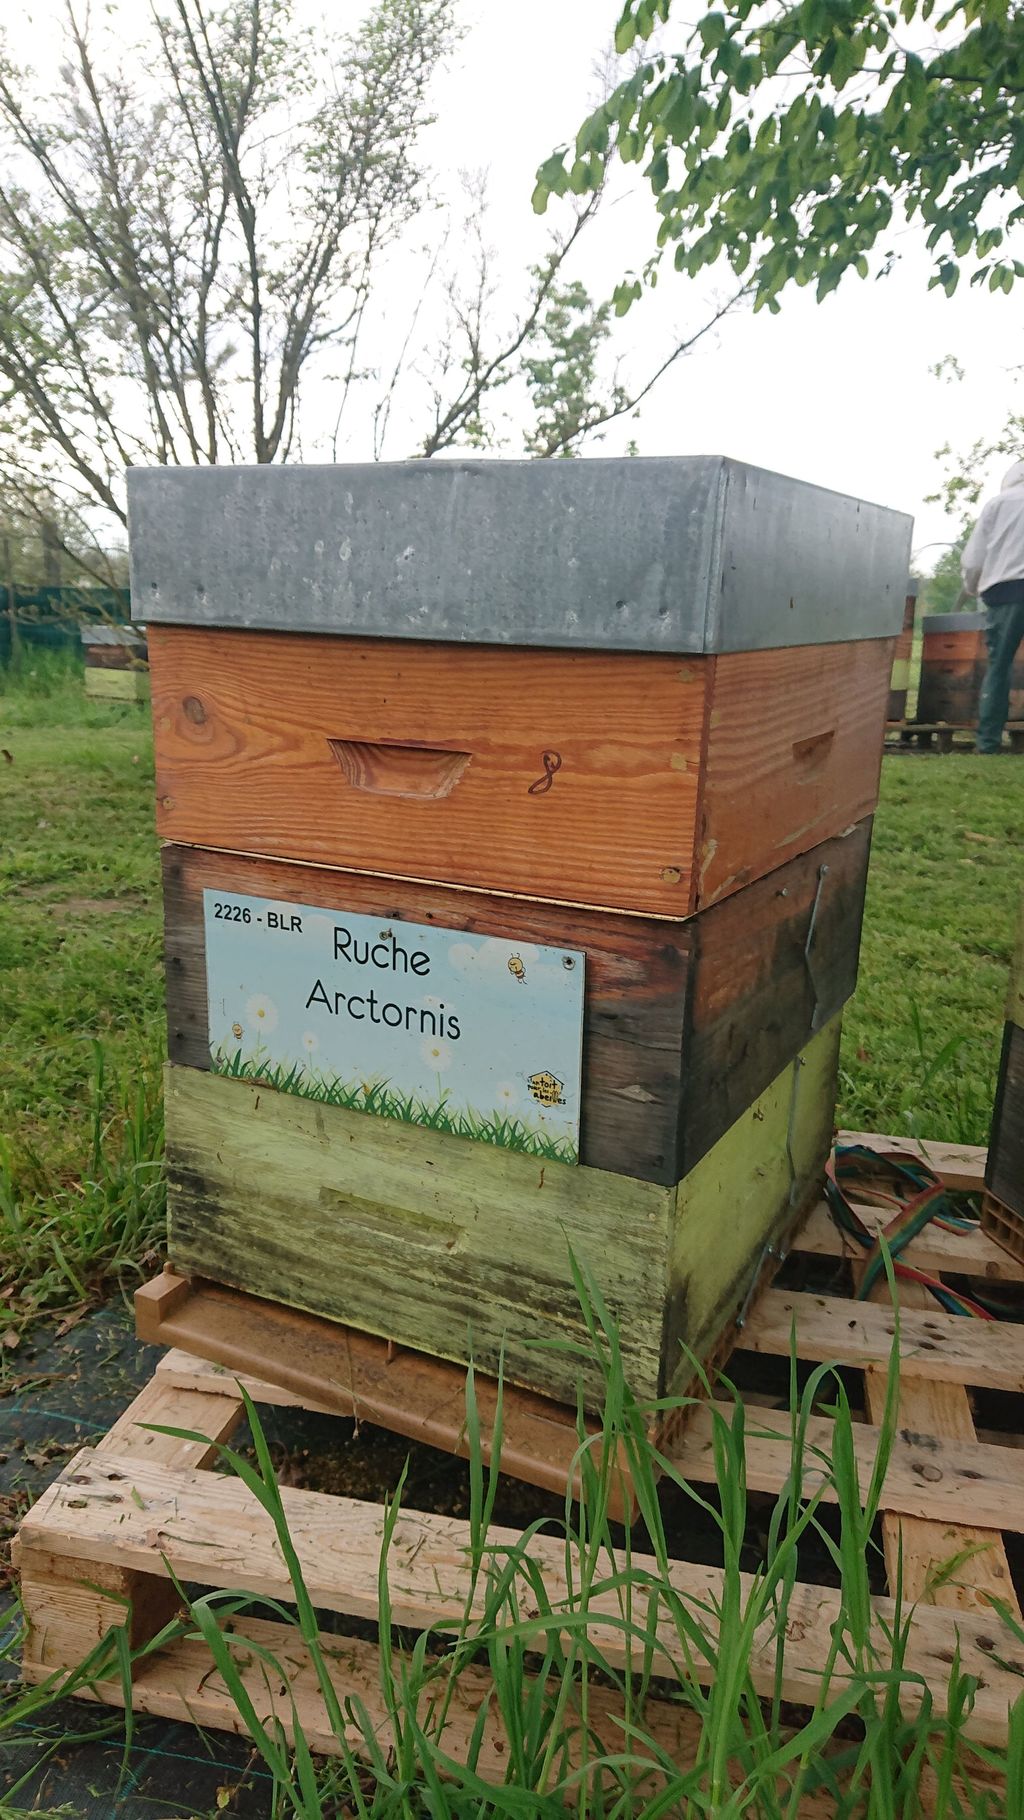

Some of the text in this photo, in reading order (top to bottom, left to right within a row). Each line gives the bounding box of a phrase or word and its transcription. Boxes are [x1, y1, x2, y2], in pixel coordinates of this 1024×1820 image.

[528, 749, 562, 795] 8
[214, 903, 251, 924] 2226
[267, 911, 303, 933] BLR
[334, 926, 431, 976] Ruche
[305, 979, 461, 1040] Arctornis
[540, 1077, 558, 1089] toit
